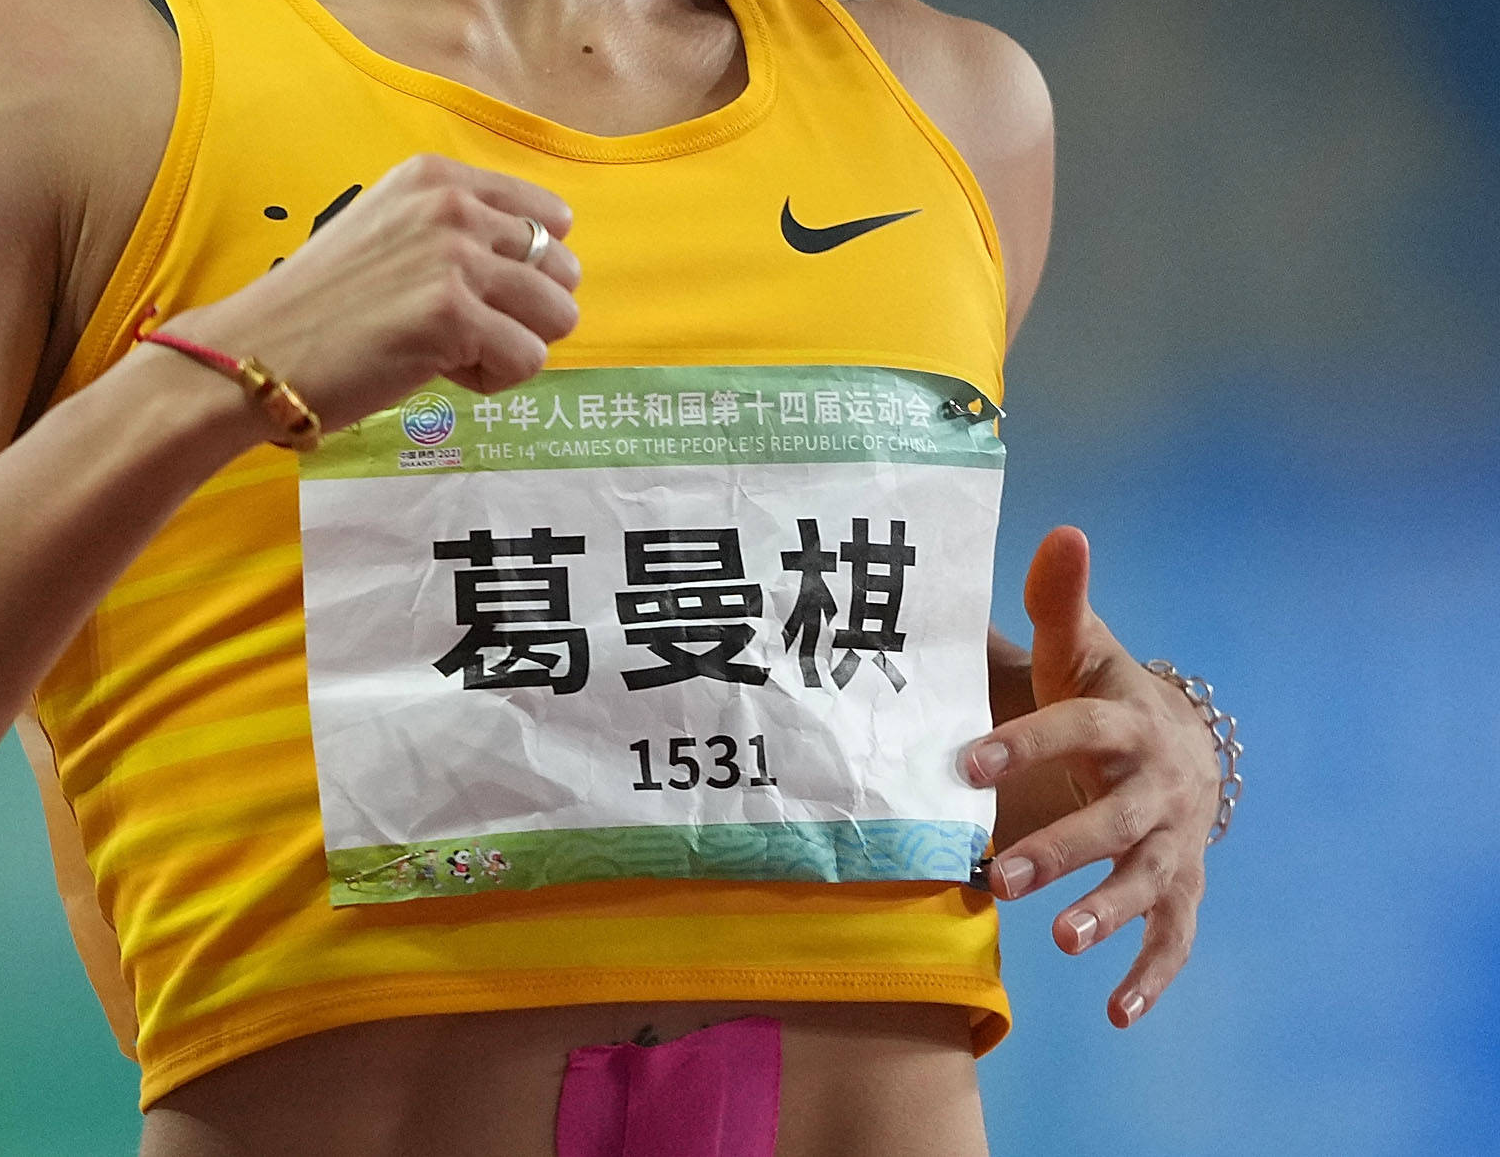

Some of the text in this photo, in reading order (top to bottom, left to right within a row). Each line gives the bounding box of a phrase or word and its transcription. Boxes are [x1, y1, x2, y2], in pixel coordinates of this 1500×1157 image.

[473, 389, 932, 434] 中华人民共和国第十四届运动会
[476, 443, 514, 460] THE
[548, 439, 612, 458] GAMES
[615, 439, 641, 455] OF
[642, 438, 677, 454] THE
[681, 435, 766, 454] PEOPLE'S
[770, 435, 861, 454] REPUBLIC
[862, 434, 886, 451] OF
[889, 434, 939, 453] CHINA
[431, 517, 916, 695] 葛曼棋
[629, 734, 778, 792] 1531
